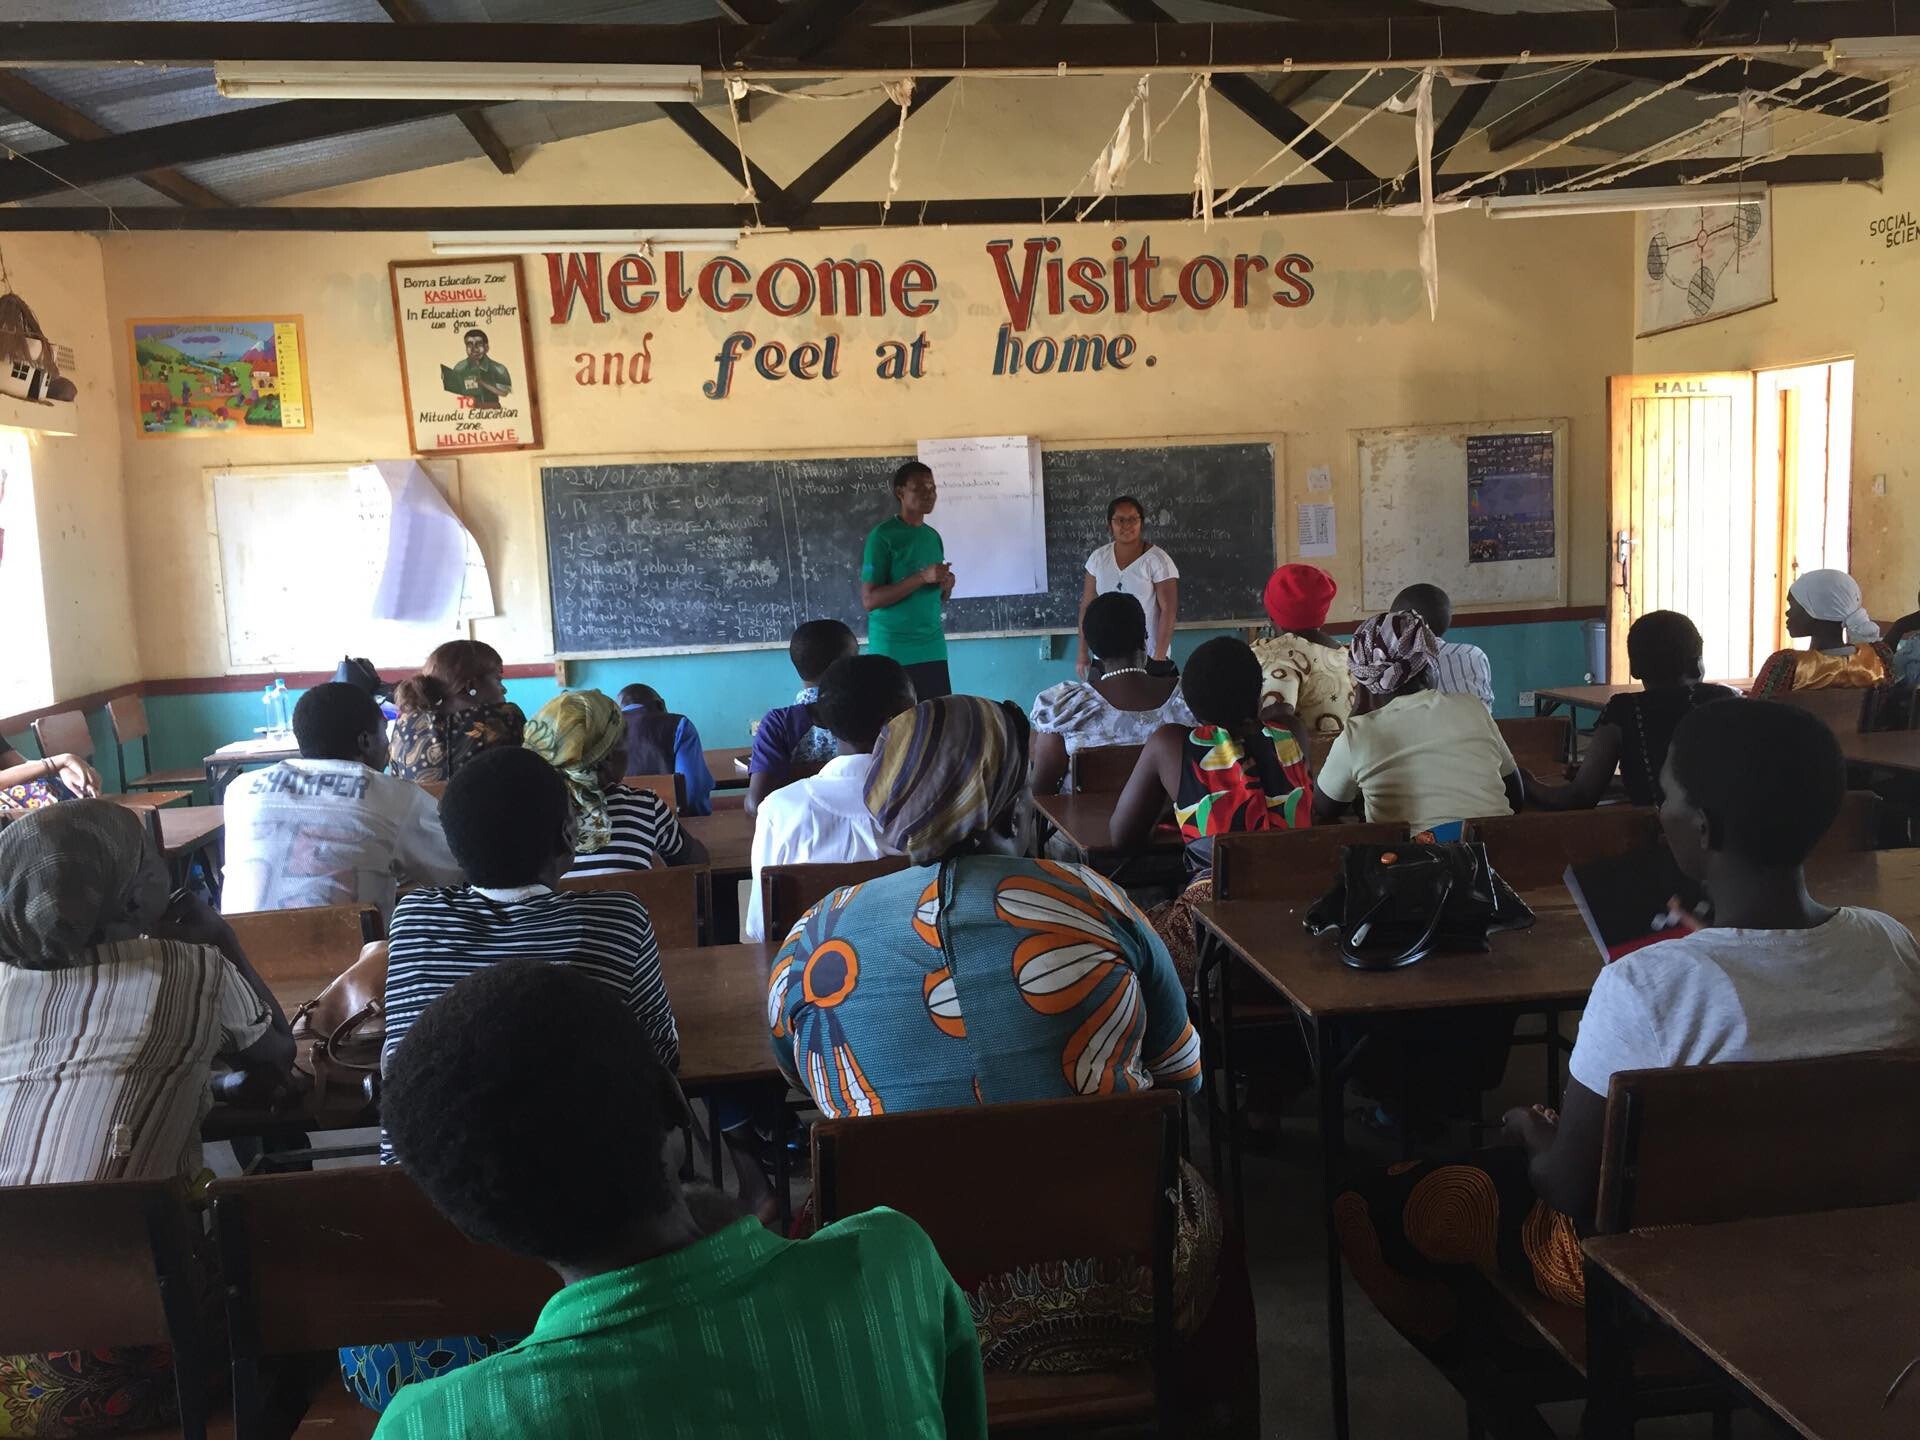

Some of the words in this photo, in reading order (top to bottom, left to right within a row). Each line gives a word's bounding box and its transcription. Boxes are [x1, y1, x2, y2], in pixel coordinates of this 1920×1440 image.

[1869, 211, 1917, 237] SOCIAL
[403, 277, 436, 288] Boma
[439, 275, 481, 287] Education
[484, 274, 507, 283] Zone
[541, 251, 940, 325] Welcome
[986, 236, 1315, 332] Visitors
[407, 309, 418, 321] In
[421, 306, 471, 320] Education
[475, 305, 517, 325] together
[431, 321, 446, 330] we
[574, 332, 654, 386] and
[702, 331, 841, 400] feel
[876, 331, 931, 380] at
[1654, 381, 1709, 394] HALL
[456, 396, 475, 410] TO
[419, 411, 466, 423] Mitundu
[468, 408, 518, 421] Education
